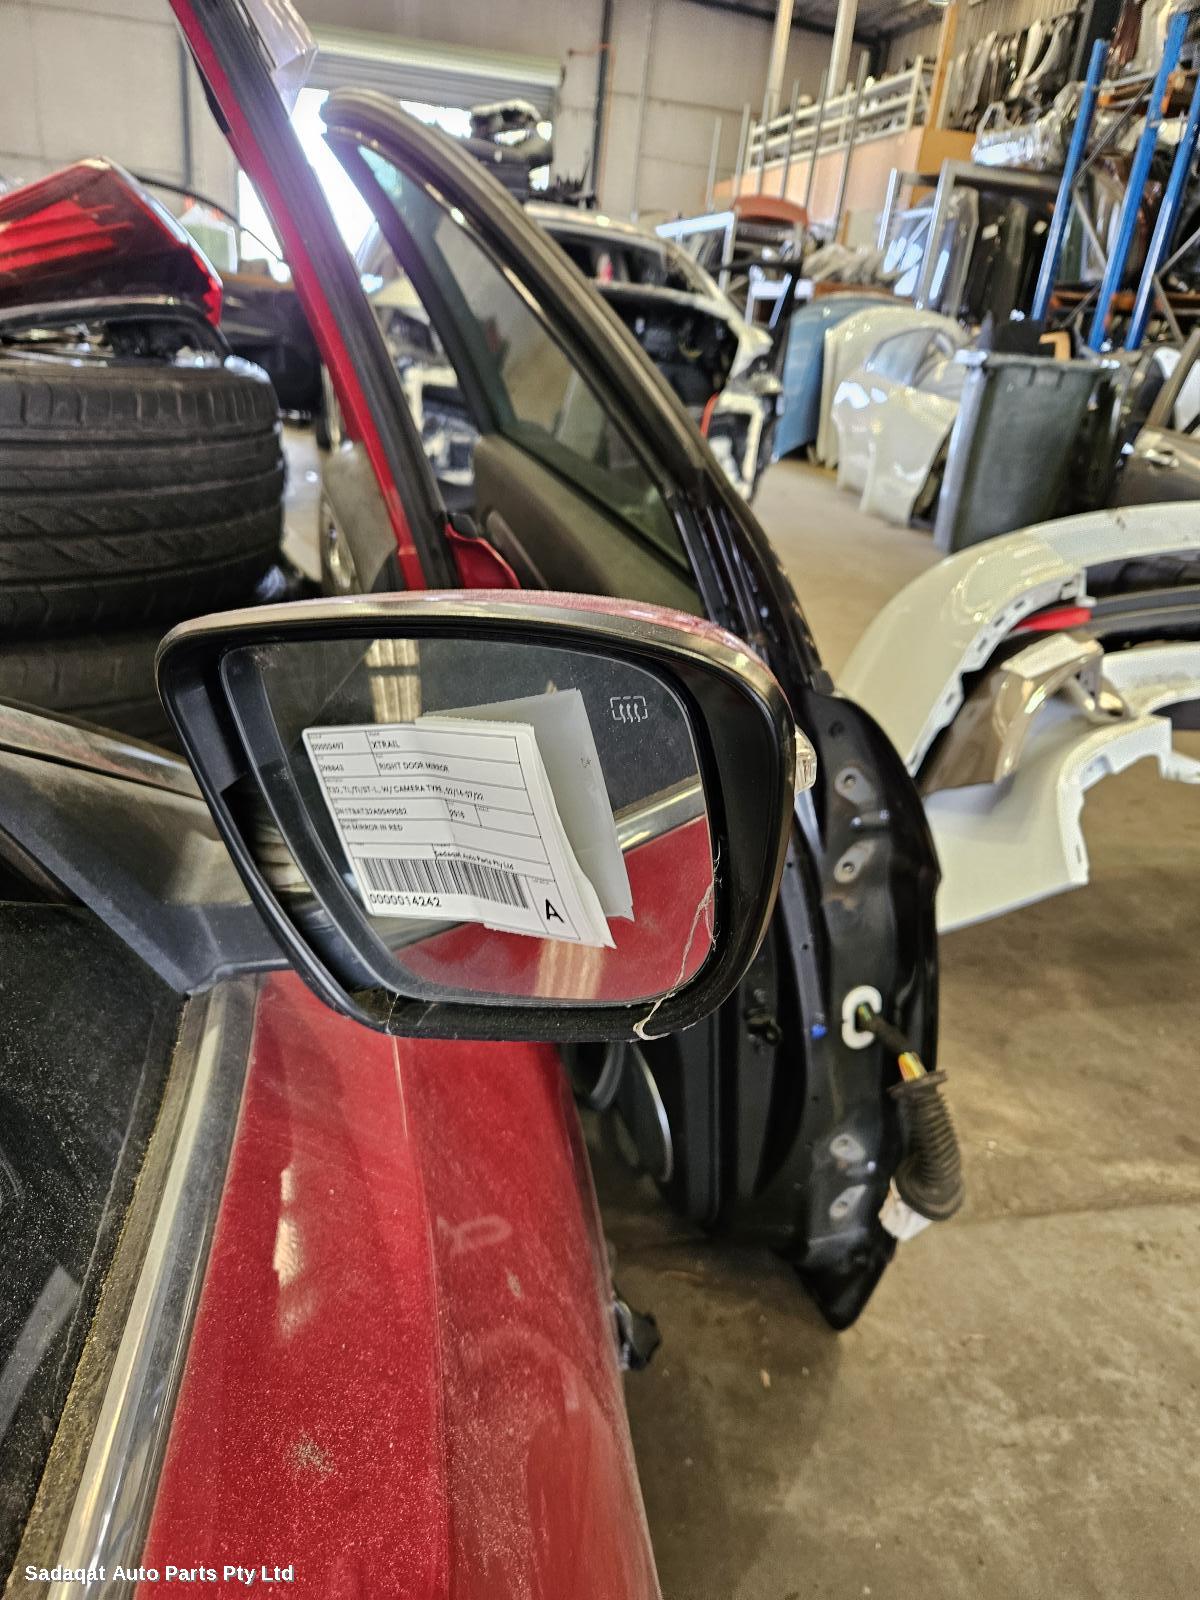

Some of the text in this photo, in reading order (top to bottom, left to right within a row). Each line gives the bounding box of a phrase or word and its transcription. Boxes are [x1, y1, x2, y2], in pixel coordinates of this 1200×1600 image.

[371, 740, 401, 750] XTRAIL
[379, 761, 449, 773] RIGHT DOOR MIRROR
[352, 823, 378, 832] MIRROR
[388, 824, 403, 832] RED
[369, 893, 443, 908] 0000014242
[545, 897, 565, 924] A
